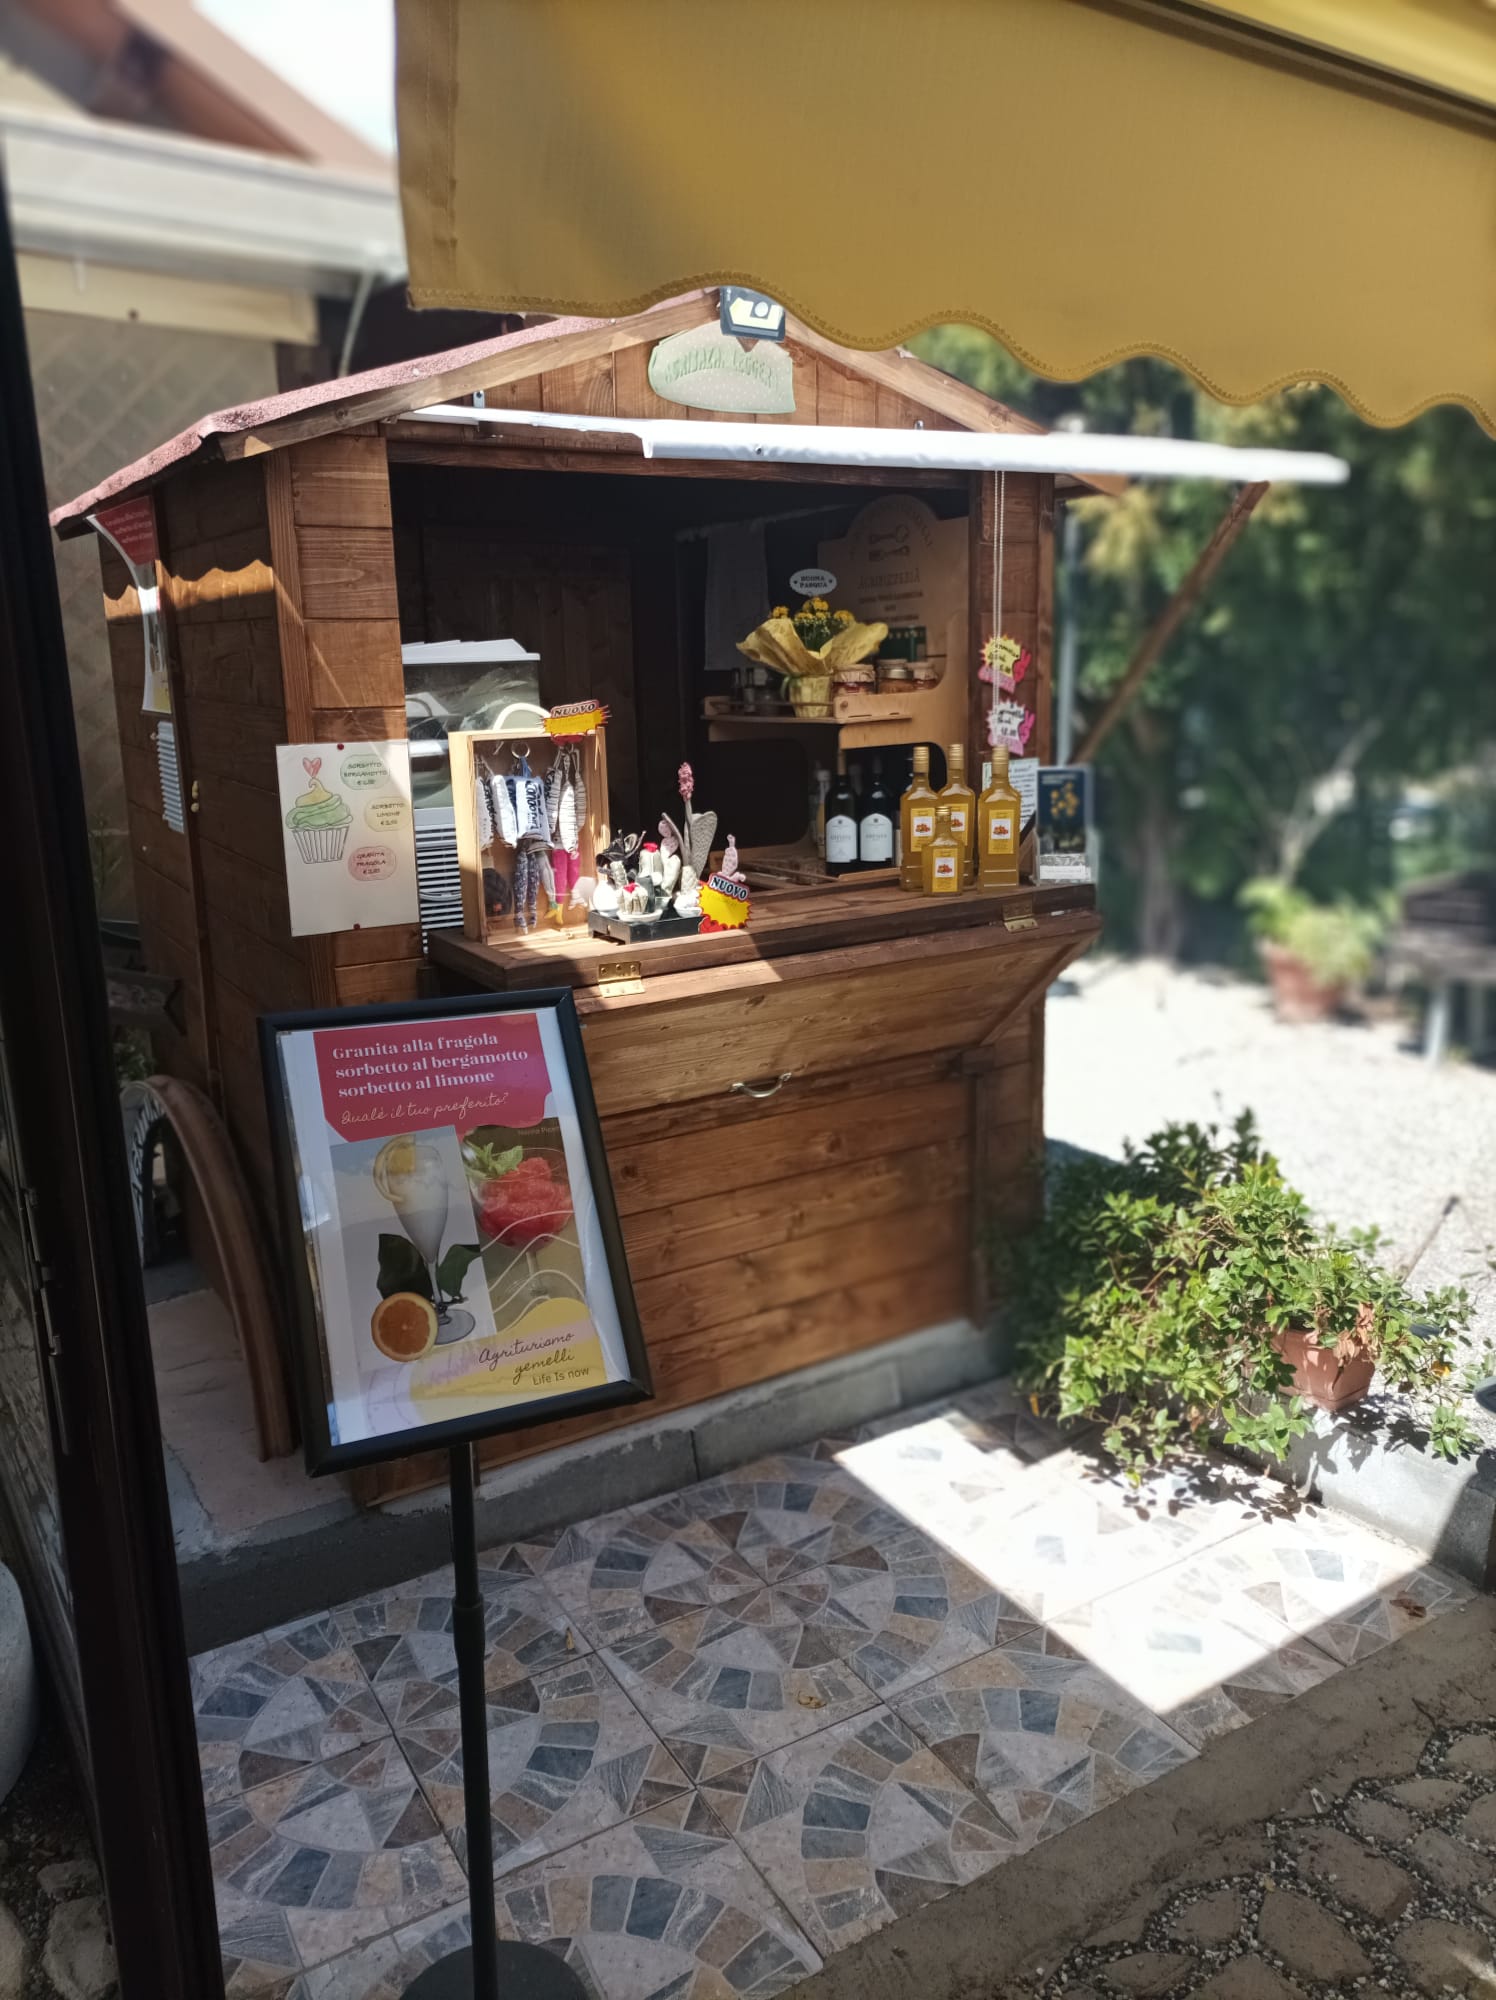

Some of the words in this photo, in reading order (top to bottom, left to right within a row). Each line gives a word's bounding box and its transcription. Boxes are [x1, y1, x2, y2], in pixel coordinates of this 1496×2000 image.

[554, 703, 596, 717] NUOVO
[711, 876, 748, 899] NUOVO
[332, 1042, 399, 1060] Granita
[402, 1039, 433, 1054] alla
[437, 1033, 499, 1051] fragola
[335, 1060, 409, 1079] sorbetto
[412, 1056, 428, 1071] al
[431, 1050, 529, 1070] bergamotto
[338, 1079, 412, 1098] sorbetto
[415, 1075, 431, 1091] al
[435, 1070, 495, 1088] limone
[390, 1104, 404, 1119] il
[407, 1101, 432, 1117] tuo
[433, 1092, 509, 1120] preferito?
[512, 1348, 575, 1386] gemelli
[532, 1373, 552, 1386] Life
[554, 1370, 565, 1381] Is
[568, 1367, 590, 1379] now
